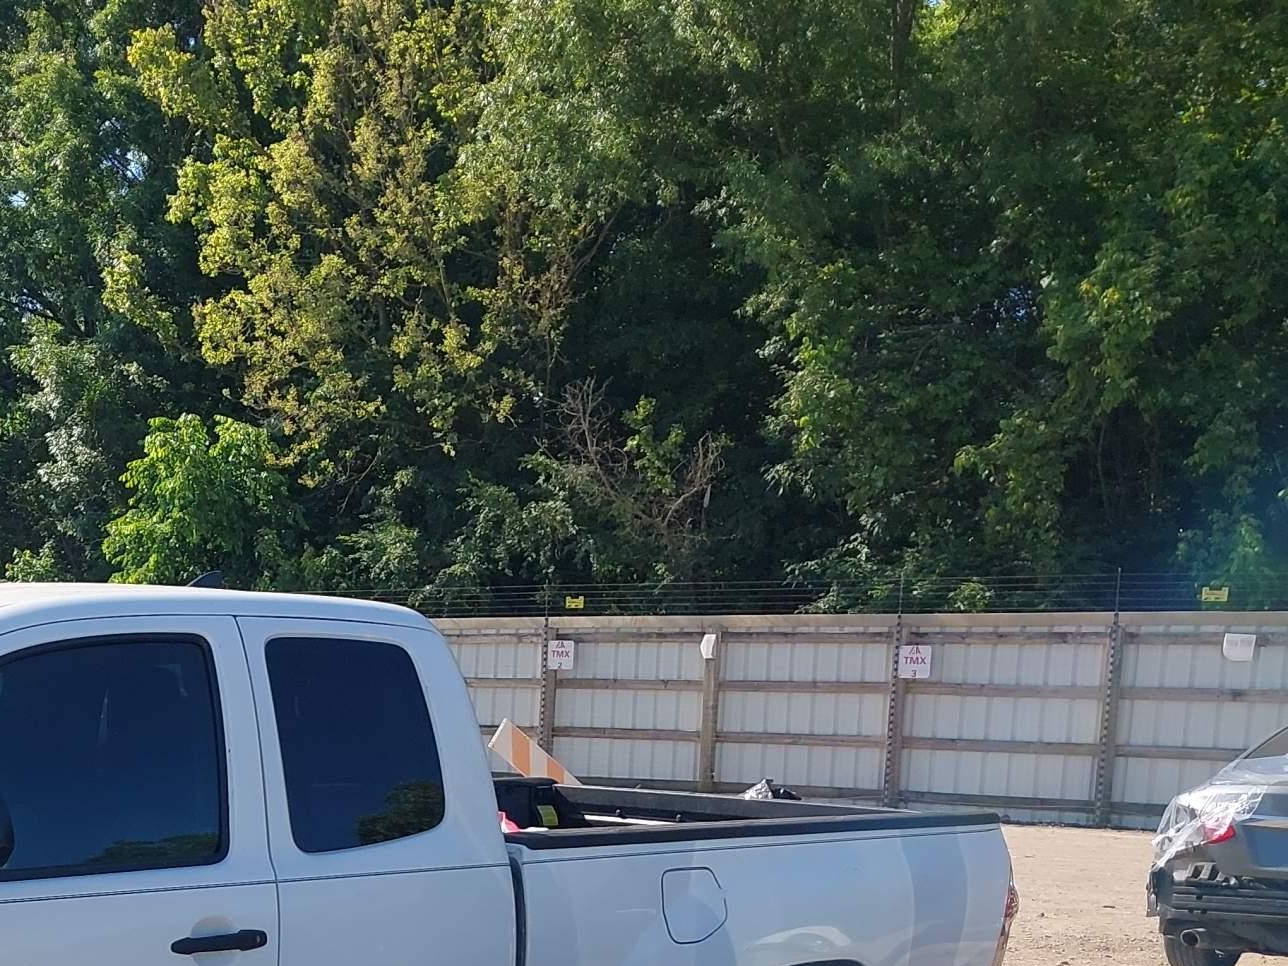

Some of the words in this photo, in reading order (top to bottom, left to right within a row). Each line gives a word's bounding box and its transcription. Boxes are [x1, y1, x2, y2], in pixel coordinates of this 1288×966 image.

[551, 650, 570, 658] TMX
[903, 656, 927, 665] TMX
[911, 669, 918, 678] 3
